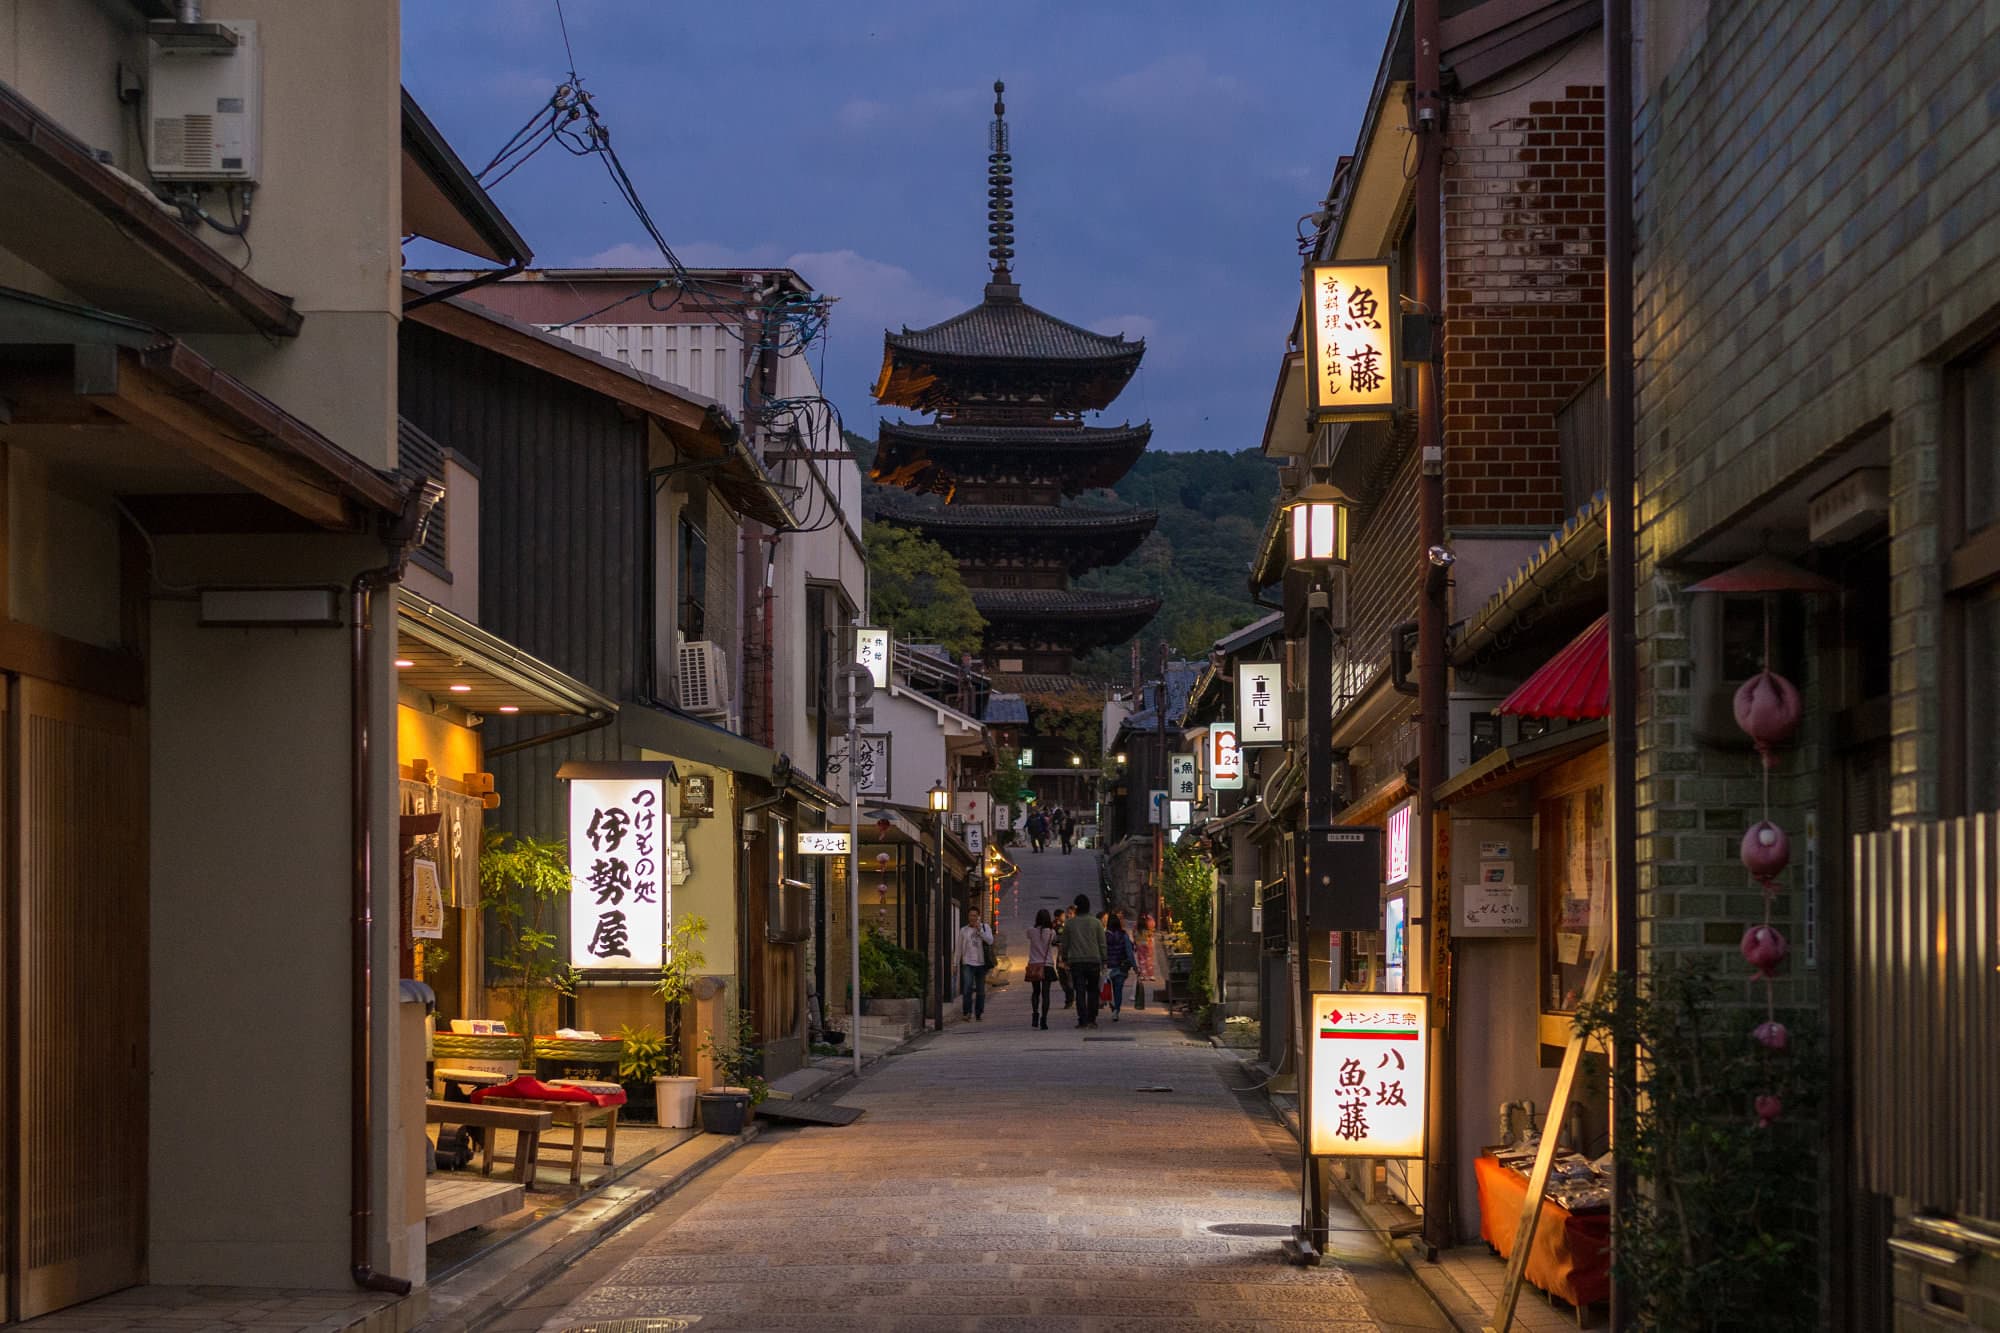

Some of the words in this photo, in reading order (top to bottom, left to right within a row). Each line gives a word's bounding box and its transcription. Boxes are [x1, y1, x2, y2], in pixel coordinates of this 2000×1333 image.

[1344, 285, 1386, 393] 魚藤
[1224, 755, 1240, 766] 24
[632, 789, 656, 904] つけもの処
[814, 838, 847, 851] ちとせ
[586, 807, 632, 959] 伊勢屋
[1479, 903, 1520, 914] ぜんざい
[1344, 1011, 1417, 1026] キンシ正宗
[1334, 1057, 1372, 1141] 魚藤
[1376, 1048, 1407, 1108] 八坂
